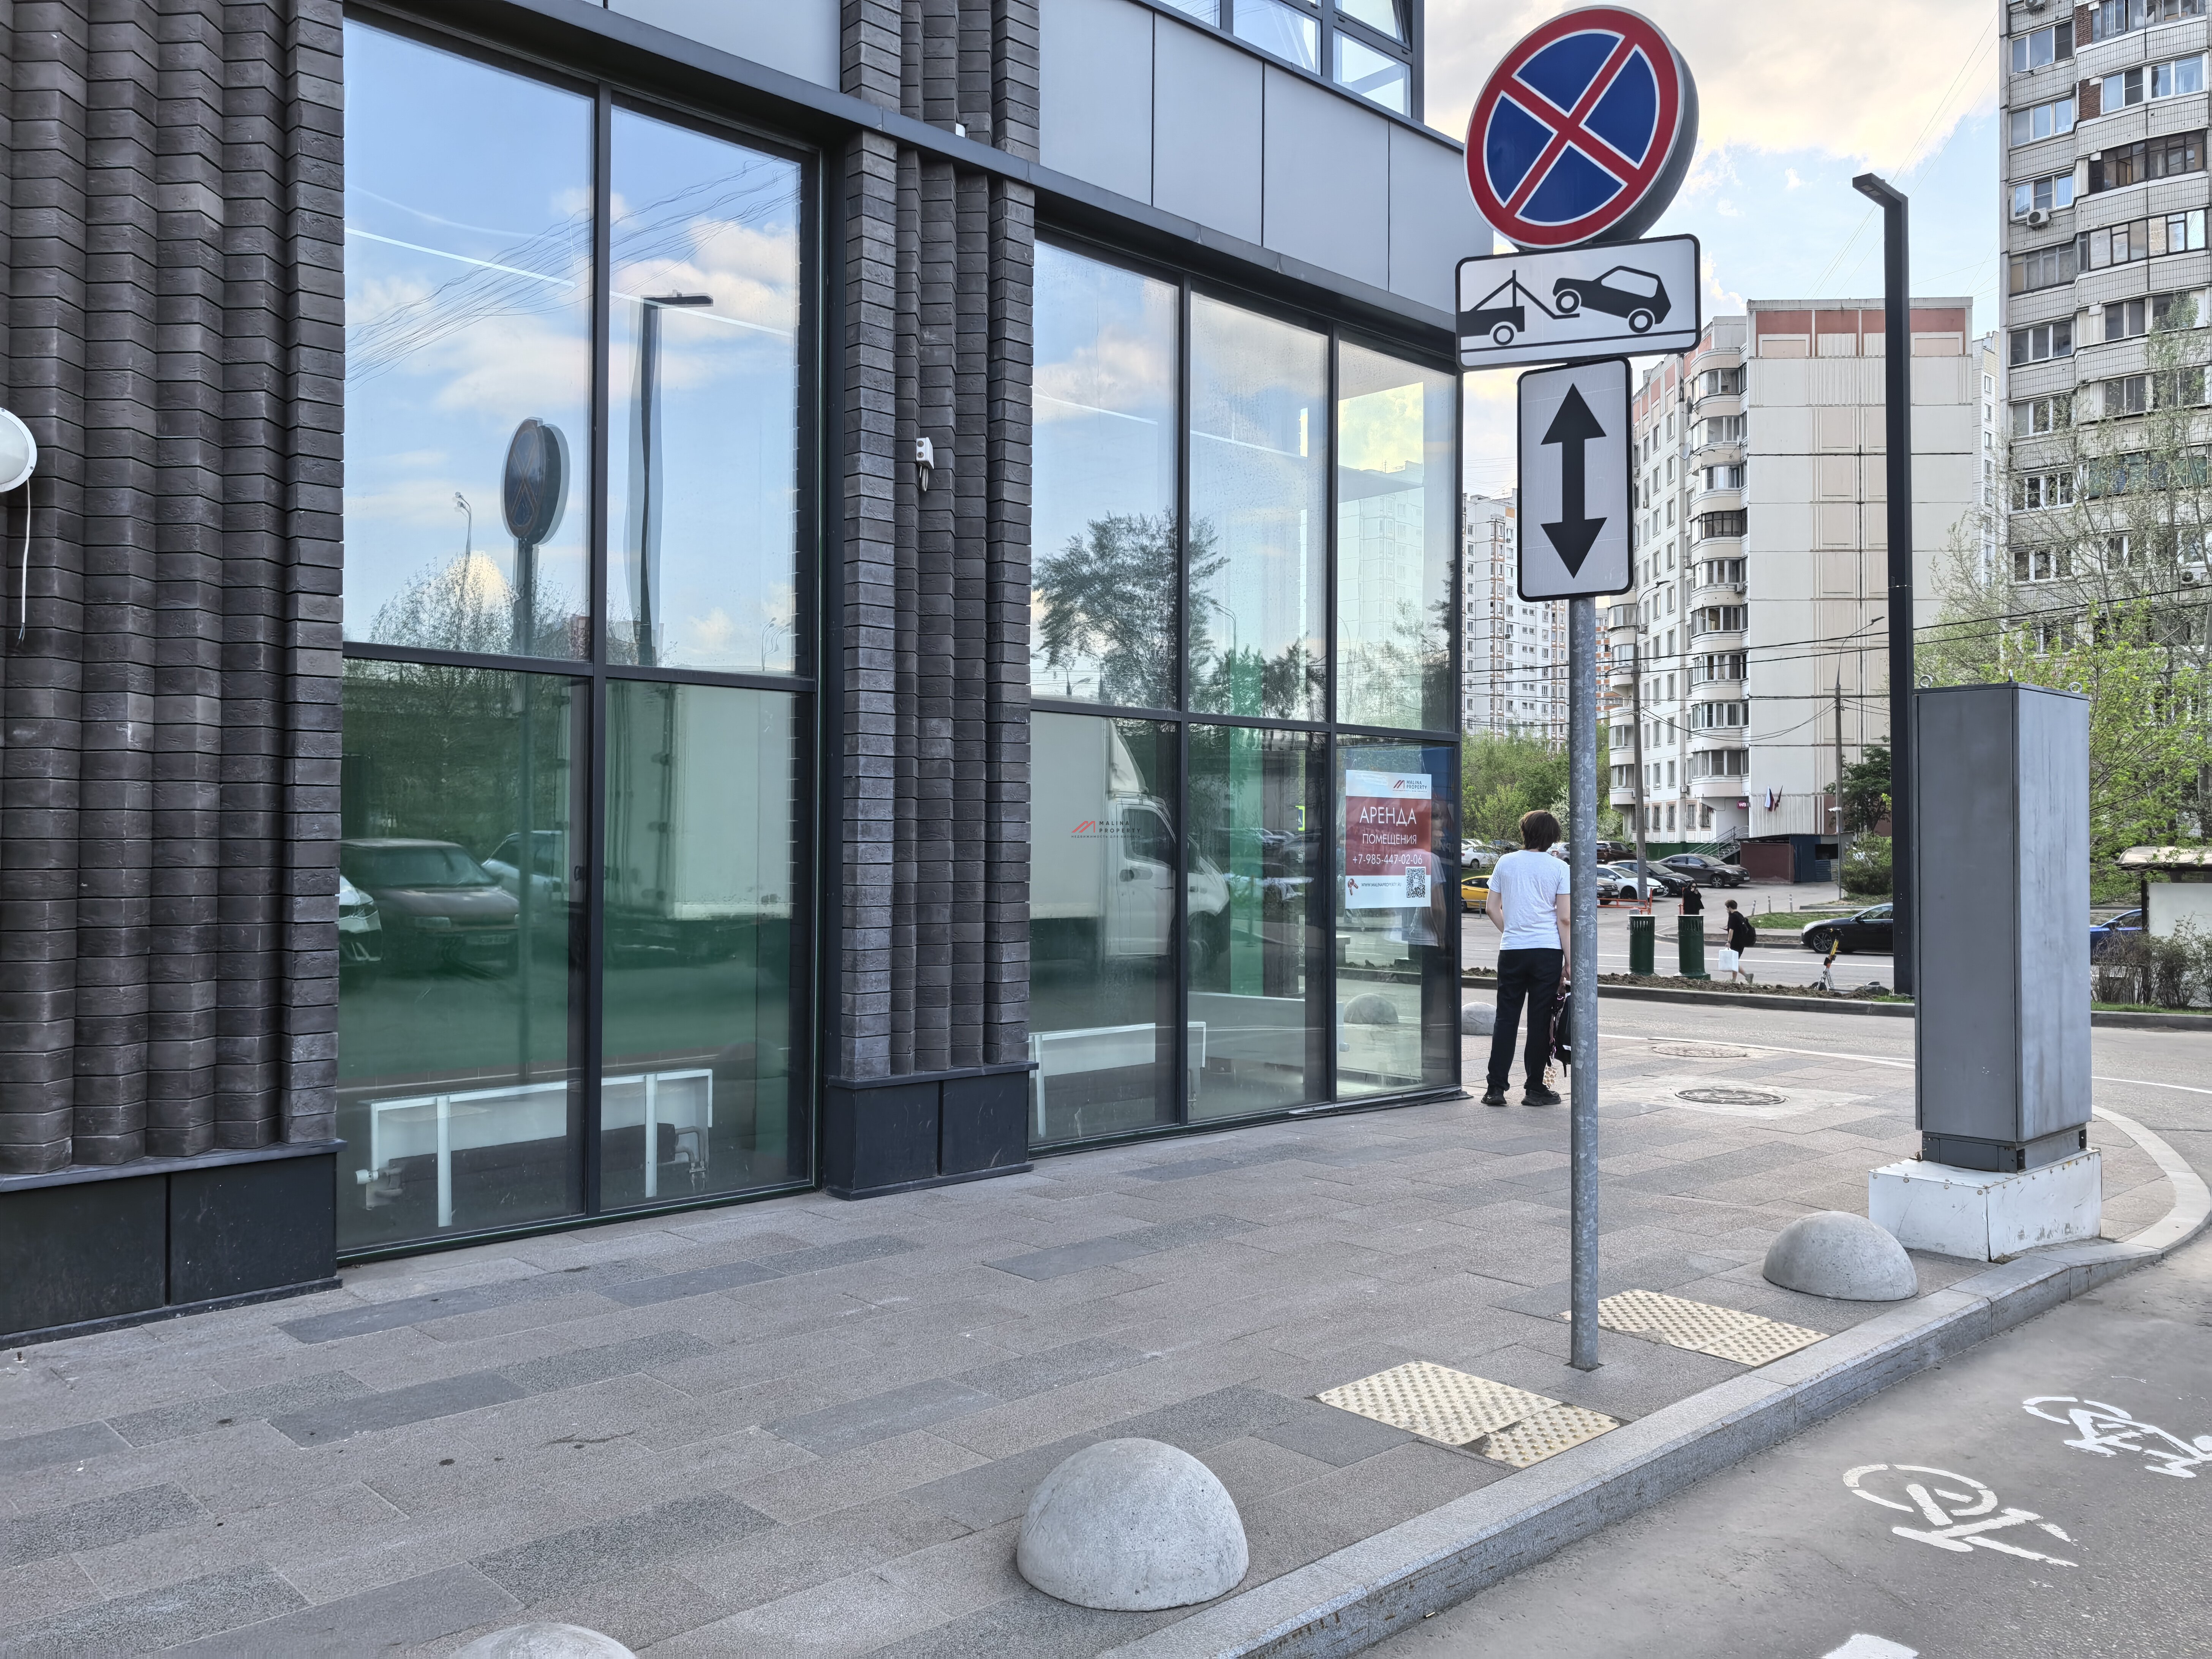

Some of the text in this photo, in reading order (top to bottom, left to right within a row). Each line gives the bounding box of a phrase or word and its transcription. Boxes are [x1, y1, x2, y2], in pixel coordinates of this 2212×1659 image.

[1359, 806, 1417, 827] АРЕНДА
[1362, 834, 1417, 846] ПОМЕЩЕНИЯ
[1352, 854, 1423, 864] +7-985-447-02-06
